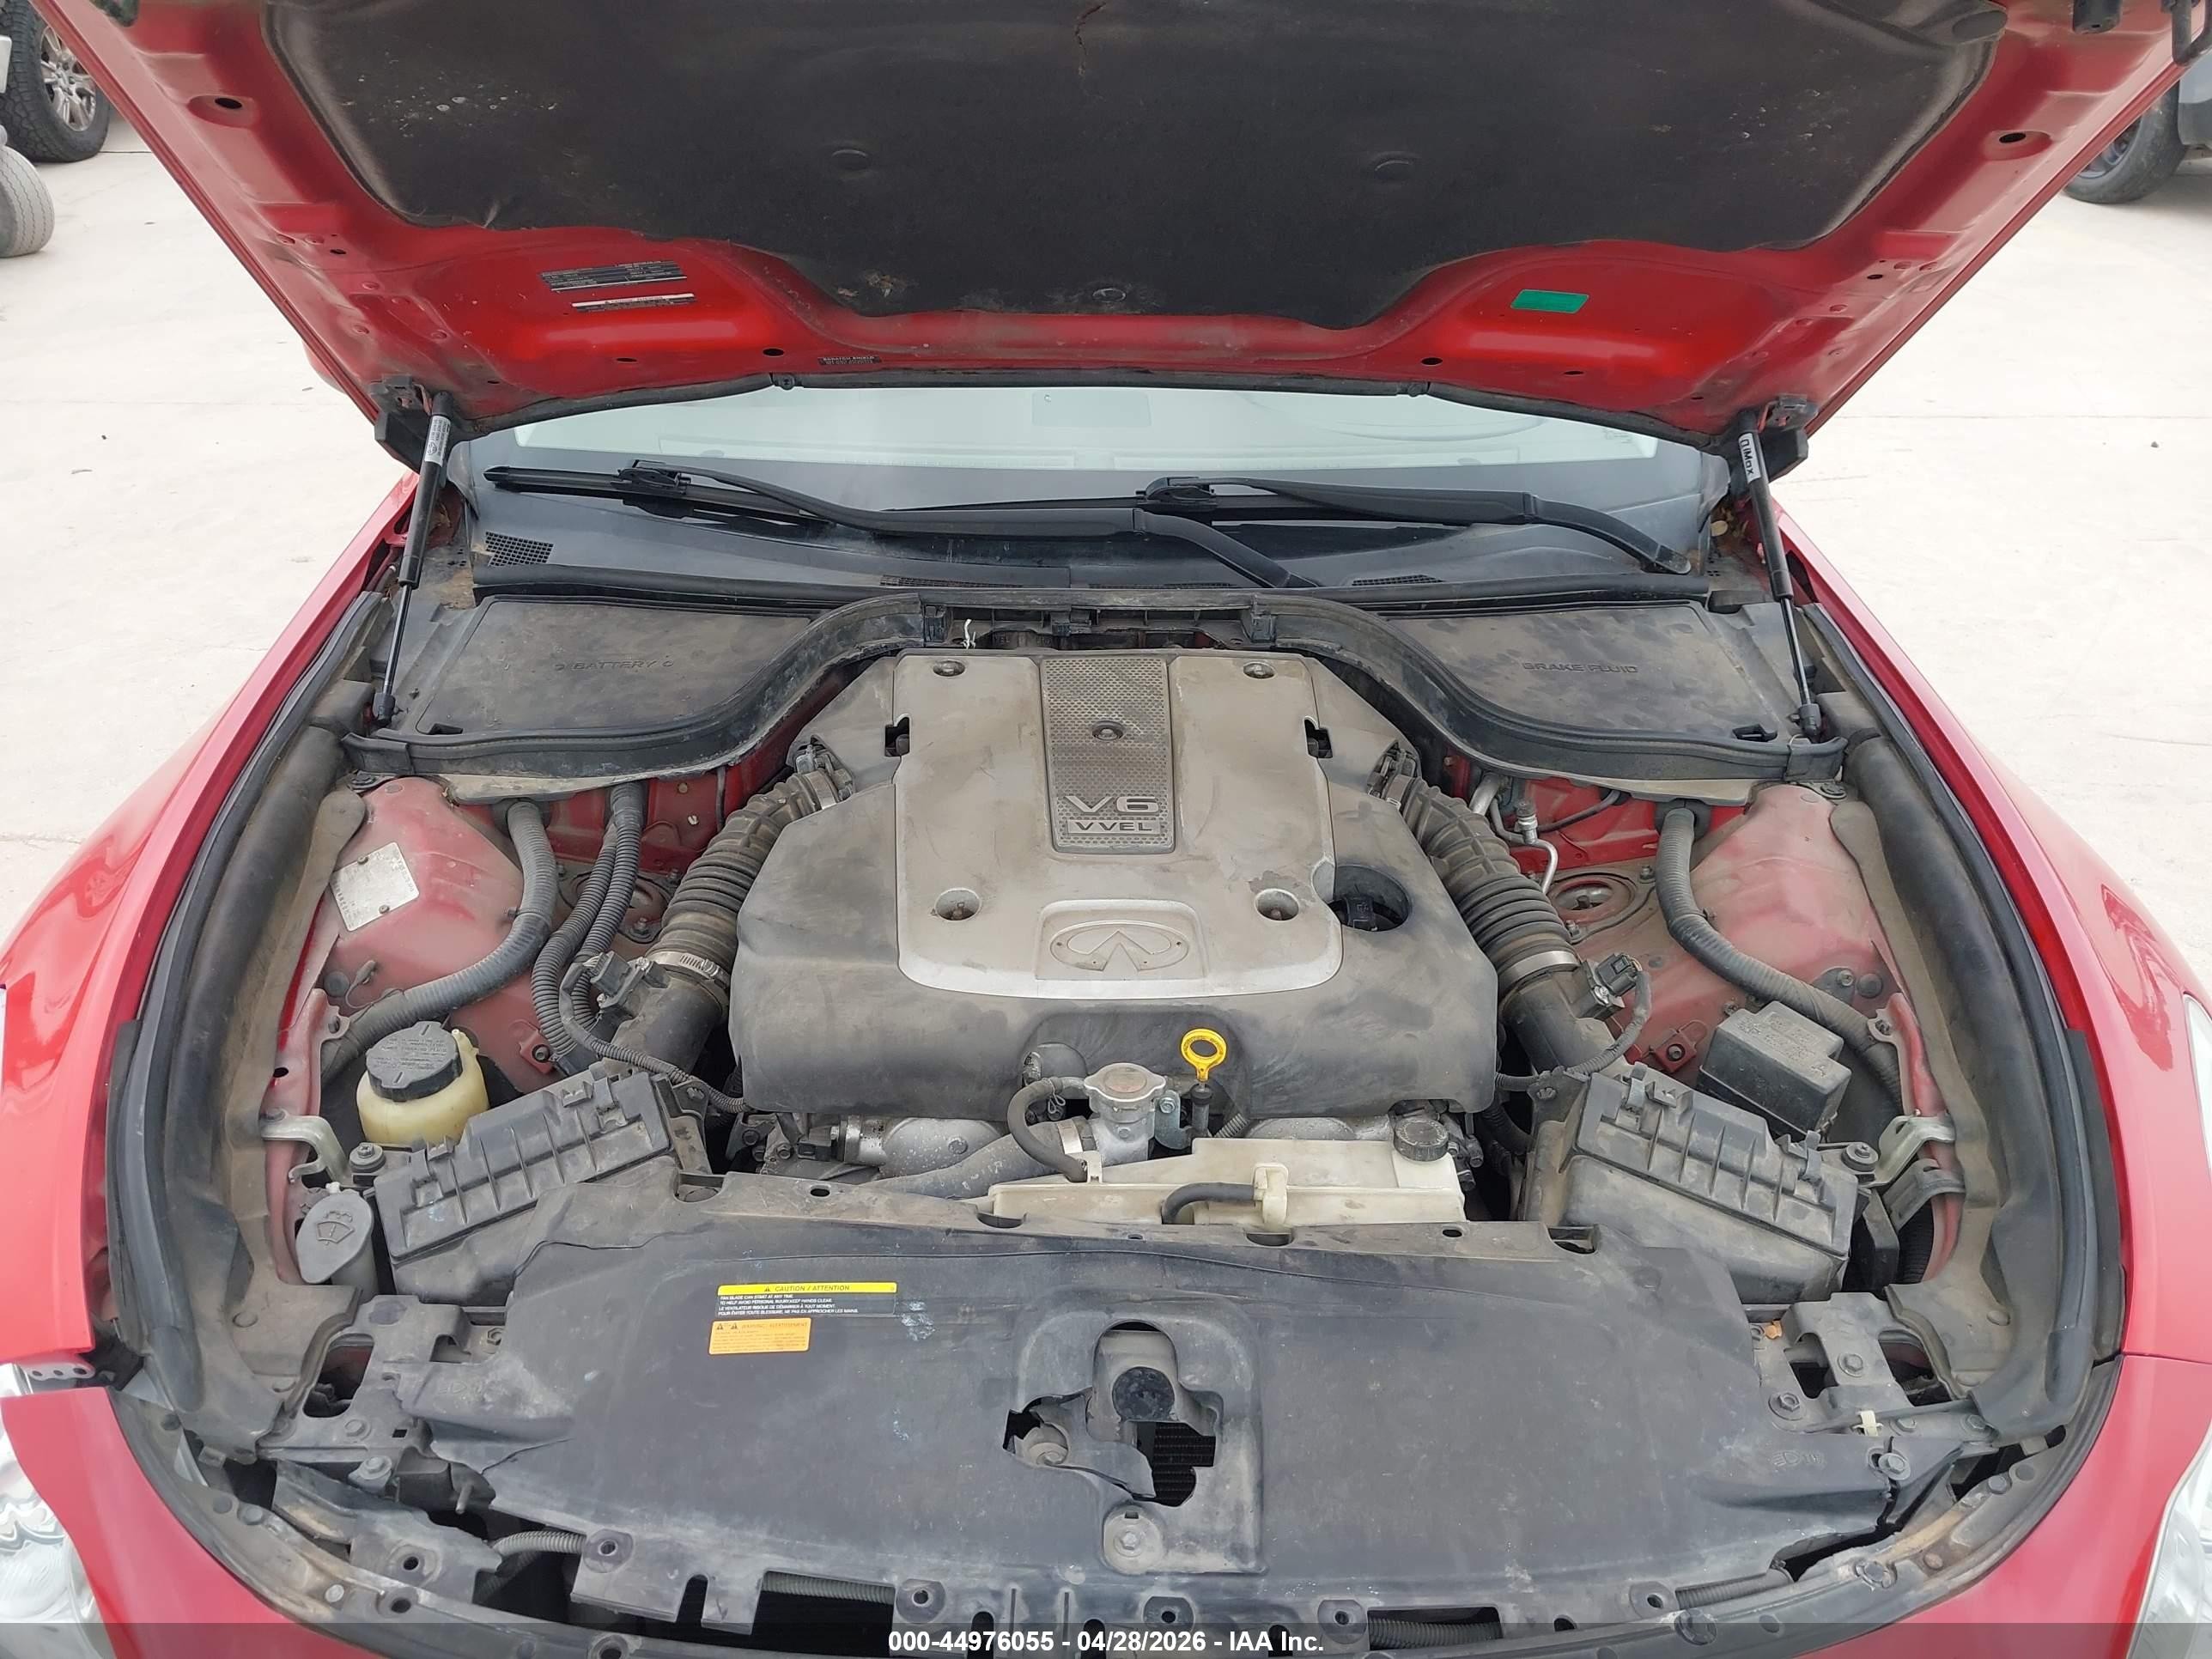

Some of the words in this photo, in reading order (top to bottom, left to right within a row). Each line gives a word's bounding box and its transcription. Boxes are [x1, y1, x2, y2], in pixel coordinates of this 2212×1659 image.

[572, 659, 657, 671] BATTERY
[1522, 662, 1584, 672] BRAKE
[1587, 664, 1639, 673] FLUID
[1065, 795, 1159, 813] V6
[1075, 822, 1152, 831] VVEL
